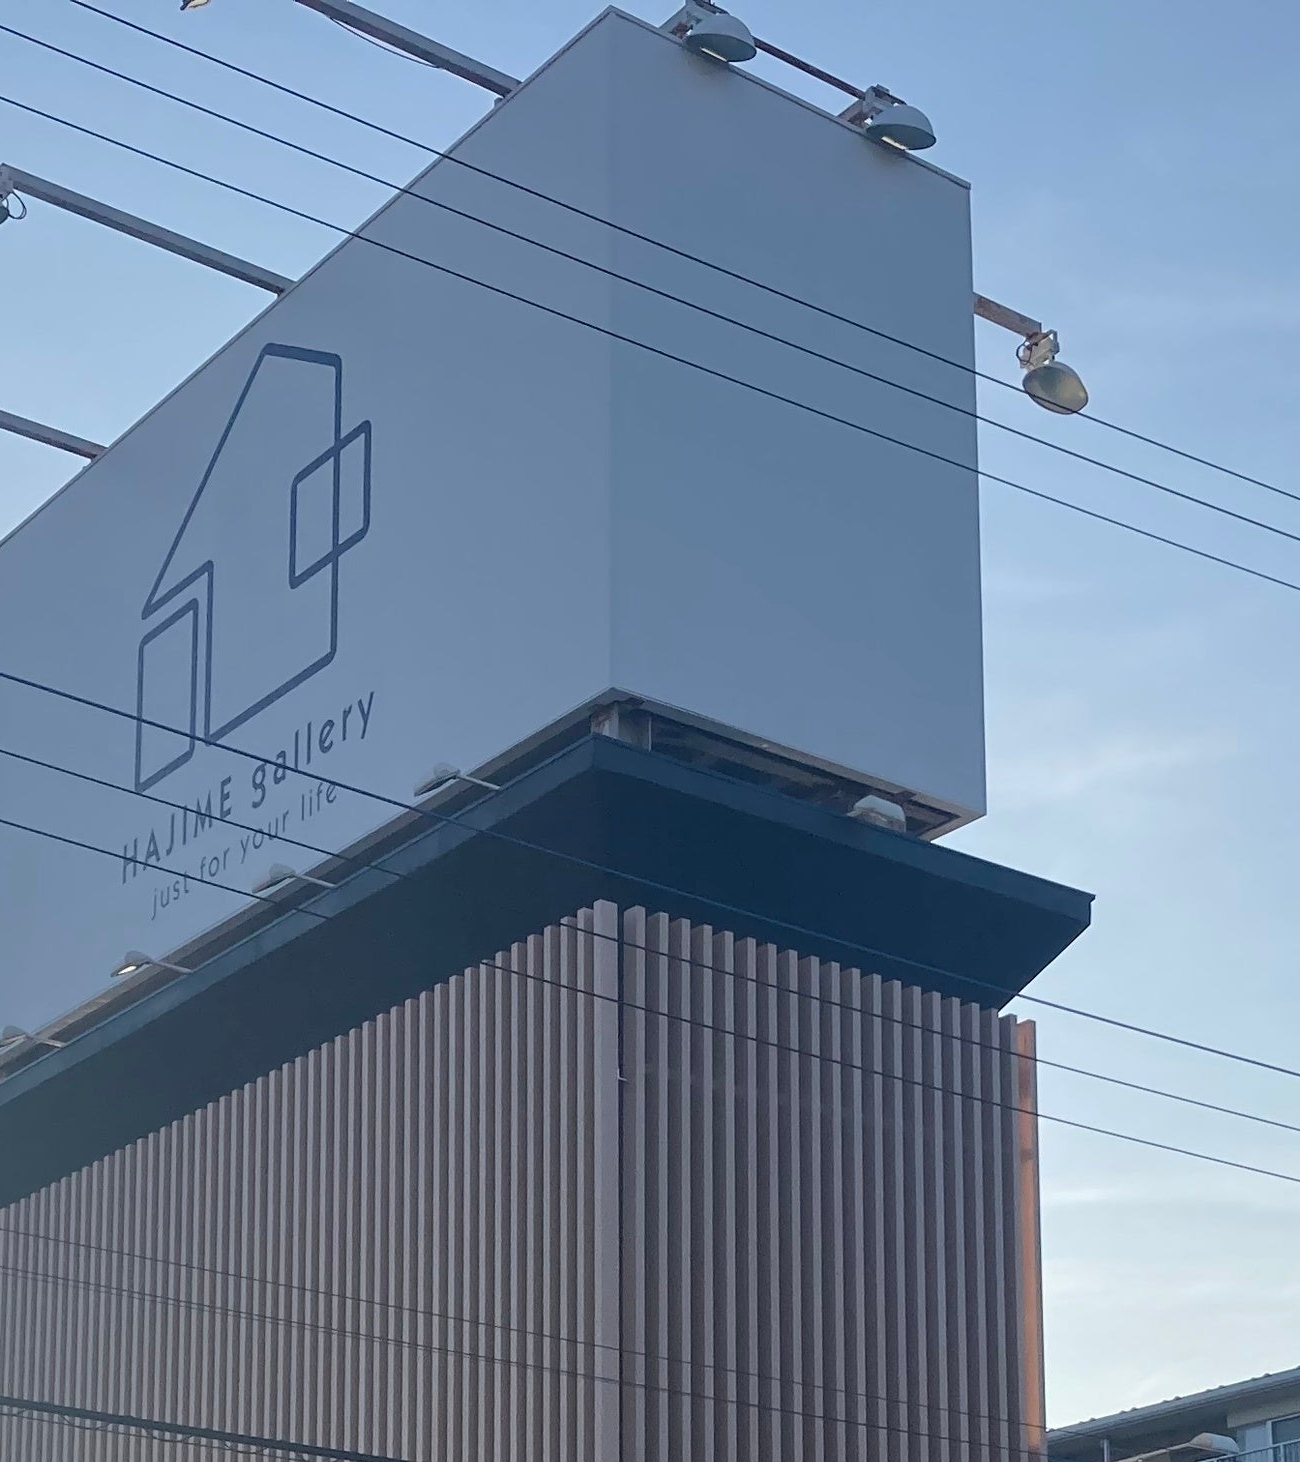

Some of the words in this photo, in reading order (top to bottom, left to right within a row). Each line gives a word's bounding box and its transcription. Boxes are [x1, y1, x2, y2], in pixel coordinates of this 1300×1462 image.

[122, 776, 232, 885] HAJIME
[251, 690, 375, 809] gallery
[150, 871, 190, 921] just
[200, 847, 231, 881] for
[240, 809, 290, 864] your
[301, 781, 338, 822] life
